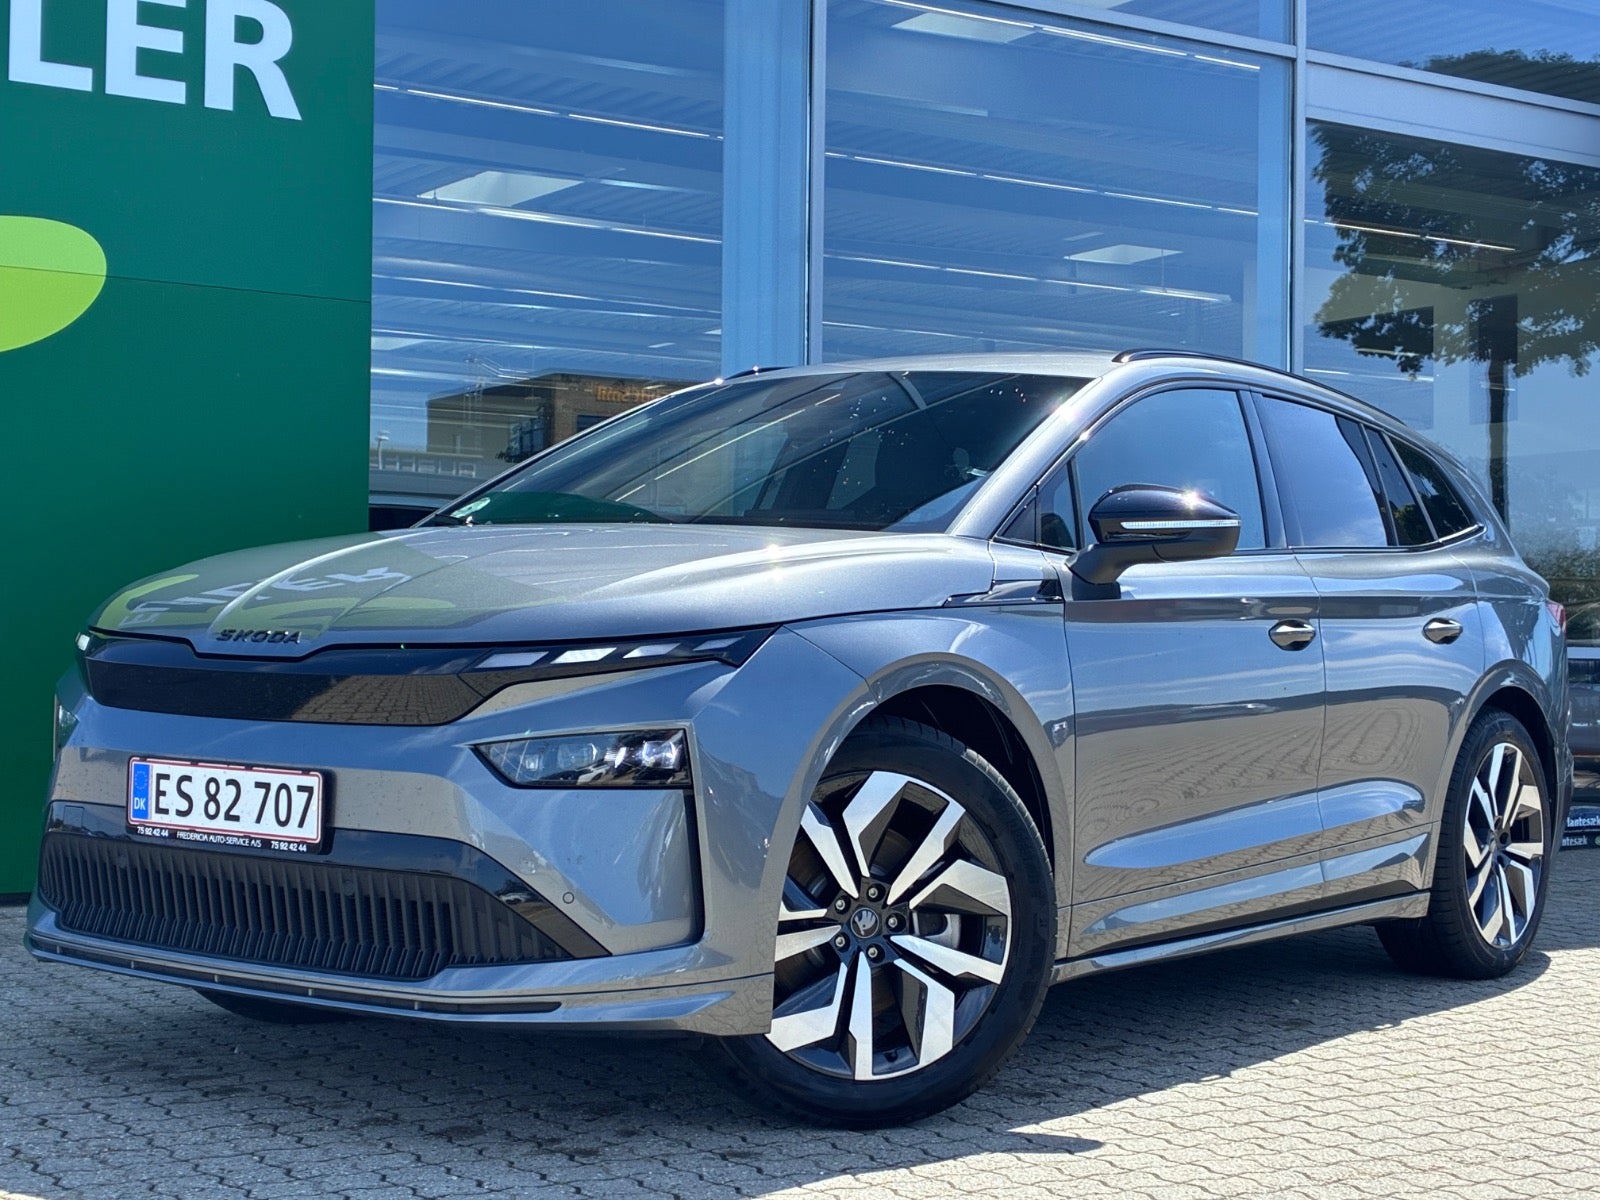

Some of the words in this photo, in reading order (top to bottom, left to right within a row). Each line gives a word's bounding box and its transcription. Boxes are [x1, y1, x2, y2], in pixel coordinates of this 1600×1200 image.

[8, 0, 303, 121] LER
[133, 797, 146, 811] DK
[155, 773, 194, 818] ES
[203, 776, 242, 823] 82
[254, 781, 314, 829] 707
[136, 826, 145, 834] 75
[144, 827, 153, 836] 92
[152, 828, 161, 837] 42
[160, 829, 169, 837] 44
[176, 831, 209, 842] FREDERICIA
[209, 834, 250, 847] AUTO-SERVICE
[250, 839, 262, 848] A/S
[270, 840, 279, 849] 75
[279, 841, 288, 851] 92
[288, 842, 298, 852] 42
[298, 844, 307, 852] 44
